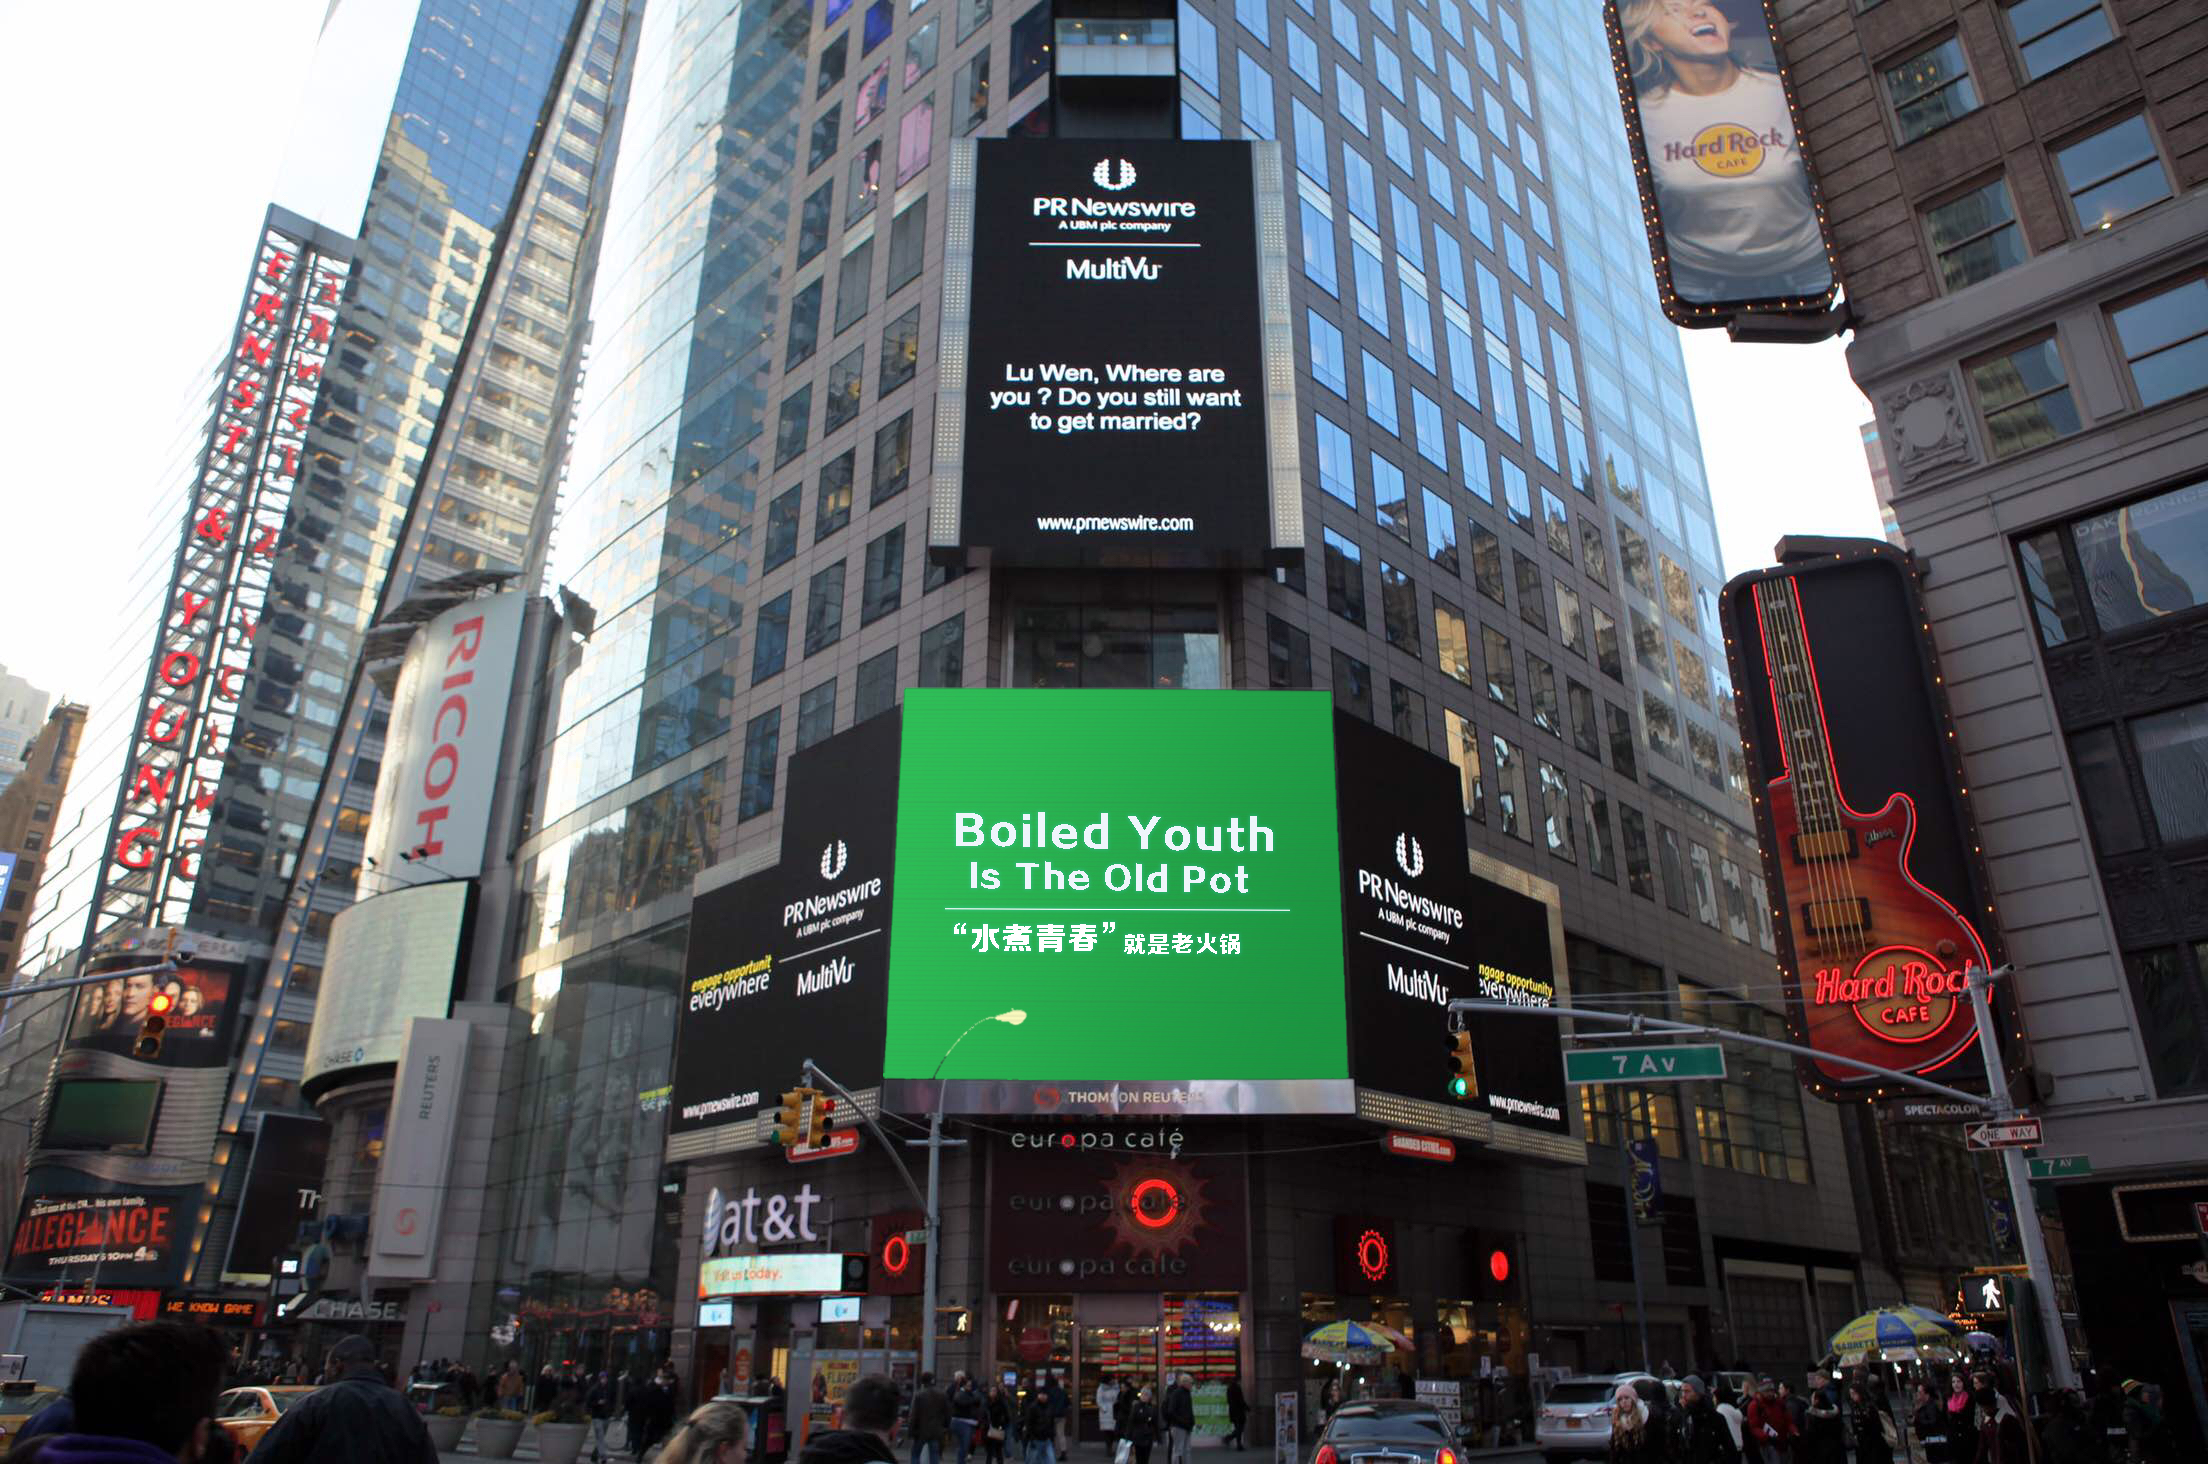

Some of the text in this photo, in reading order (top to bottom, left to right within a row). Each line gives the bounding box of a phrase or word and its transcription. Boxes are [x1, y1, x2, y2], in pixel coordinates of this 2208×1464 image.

[1663, 127, 1788, 161] Hard Rock
[1716, 158, 1748, 169] CAFE
[1033, 197, 1196, 217] PR Newswire
[1058, 219, 1172, 233] A UBM plc company
[221, 250, 290, 454] ERNST
[1006, 363, 1225, 385] Lu Wen, Where are
[990, 387, 1242, 410] you ? Do you still want
[1030, 411, 1202, 434] to get married?
[195, 507, 231, 542] &
[117, 591, 213, 869] YOUNG
[408, 615, 484, 861] RICOH
[955, 811, 1275, 852] Boiled Youth
[970, 861, 1249, 894] Is The Old Pot
[783, 878, 881, 927] PR Newswire
[1359, 869, 1463, 929] PR Newswire
[796, 908, 865, 938] A UBM plc company
[1378, 907, 1450, 944] A UBM plc company
[1123, 932, 1241, 956] 就是老火锅
[689, 972, 770, 1012] everywhere
[1505, 973, 1553, 1001] opportunity
[1815, 965, 1895, 1005] Hard
[1881, 1006, 1931, 1024] CAFE
[1612, 1054, 1676, 1074] 7 Av
[418, 1055, 441, 1120] REUTERS
[1011, 1127, 1184, 1152] europa café
[1979, 1127, 2034, 1141] ONE WAY
[2043, 1158, 2072, 1176] 7 AV
[720, 1183, 821, 1246] at&t
[13, 1206, 170, 1256] ALLEGIANCE
[167, 1301, 254, 1315] WE KNOW GAME
[313, 1298, 399, 1320] CHASE
